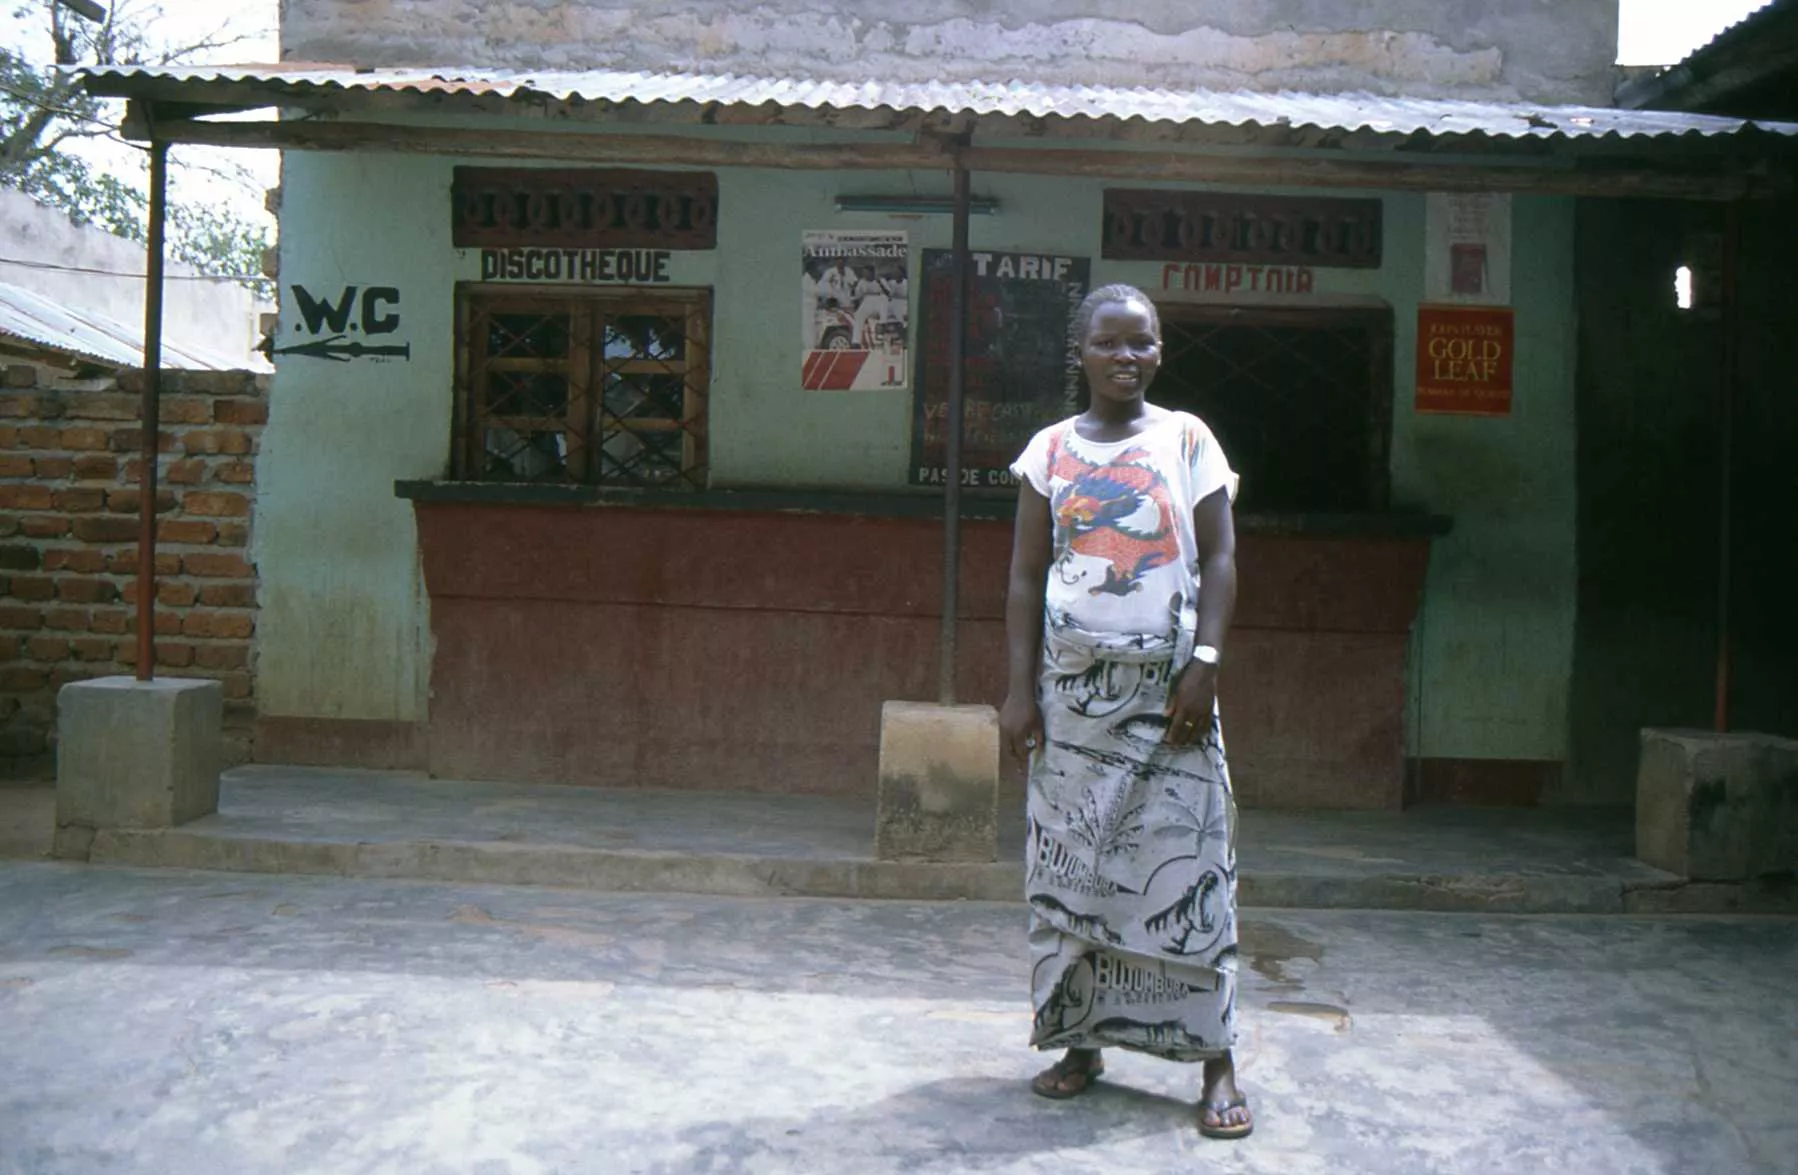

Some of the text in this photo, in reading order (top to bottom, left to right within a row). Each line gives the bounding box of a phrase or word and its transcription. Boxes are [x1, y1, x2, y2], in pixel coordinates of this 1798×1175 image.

[804, 243, 907, 257] Ambassade
[481, 249, 671, 283] DISCOTHEQUE
[972, 253, 1073, 281] TARIF
[1428, 337, 1502, 361] GOLD
[1432, 360, 1498, 382] LEAF
[1038, 831, 1117, 891] BUJUMBURA
[1095, 953, 1190, 995] BUJUMBURA
